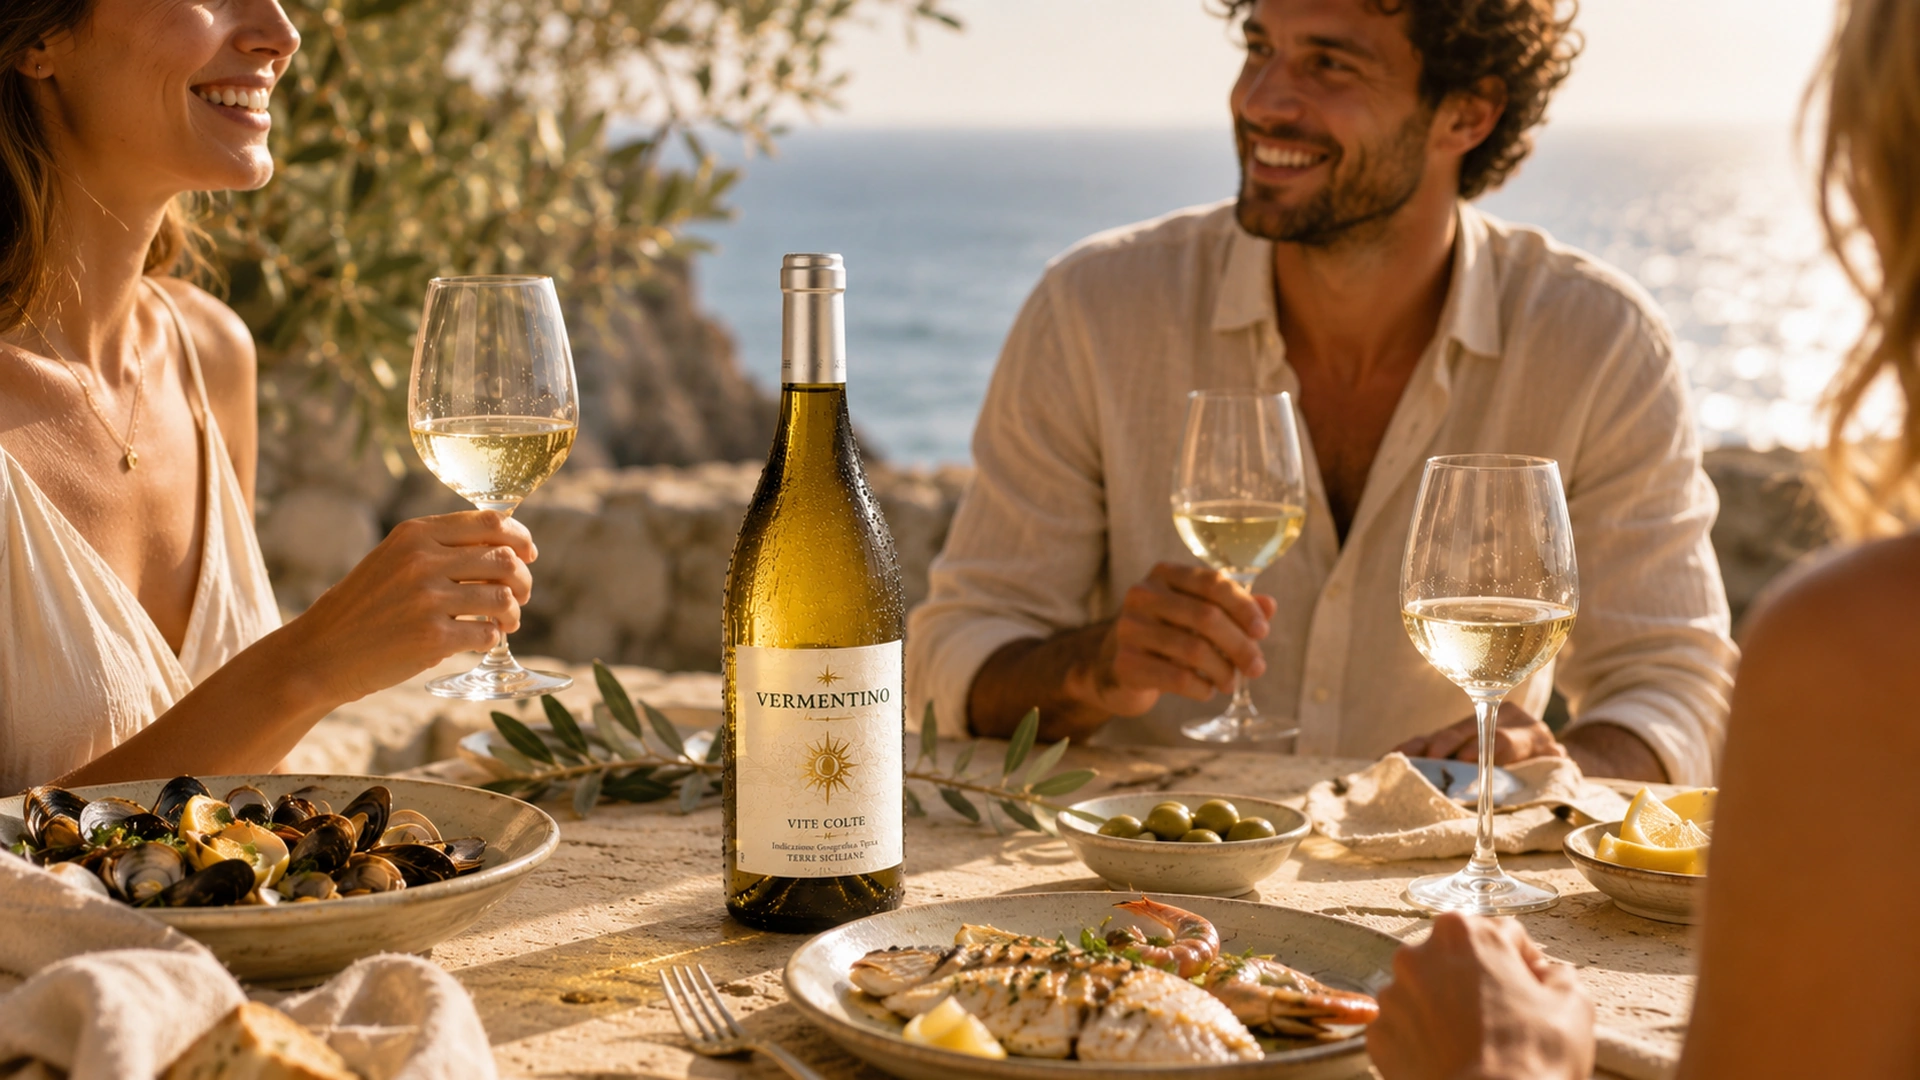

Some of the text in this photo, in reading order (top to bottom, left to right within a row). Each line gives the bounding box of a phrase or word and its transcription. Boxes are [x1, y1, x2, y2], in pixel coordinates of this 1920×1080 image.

[756, 688, 890, 709] VERMENTINO
[787, 816, 866, 829] VITE COLTE
[786, 853, 817, 862] TERRE
